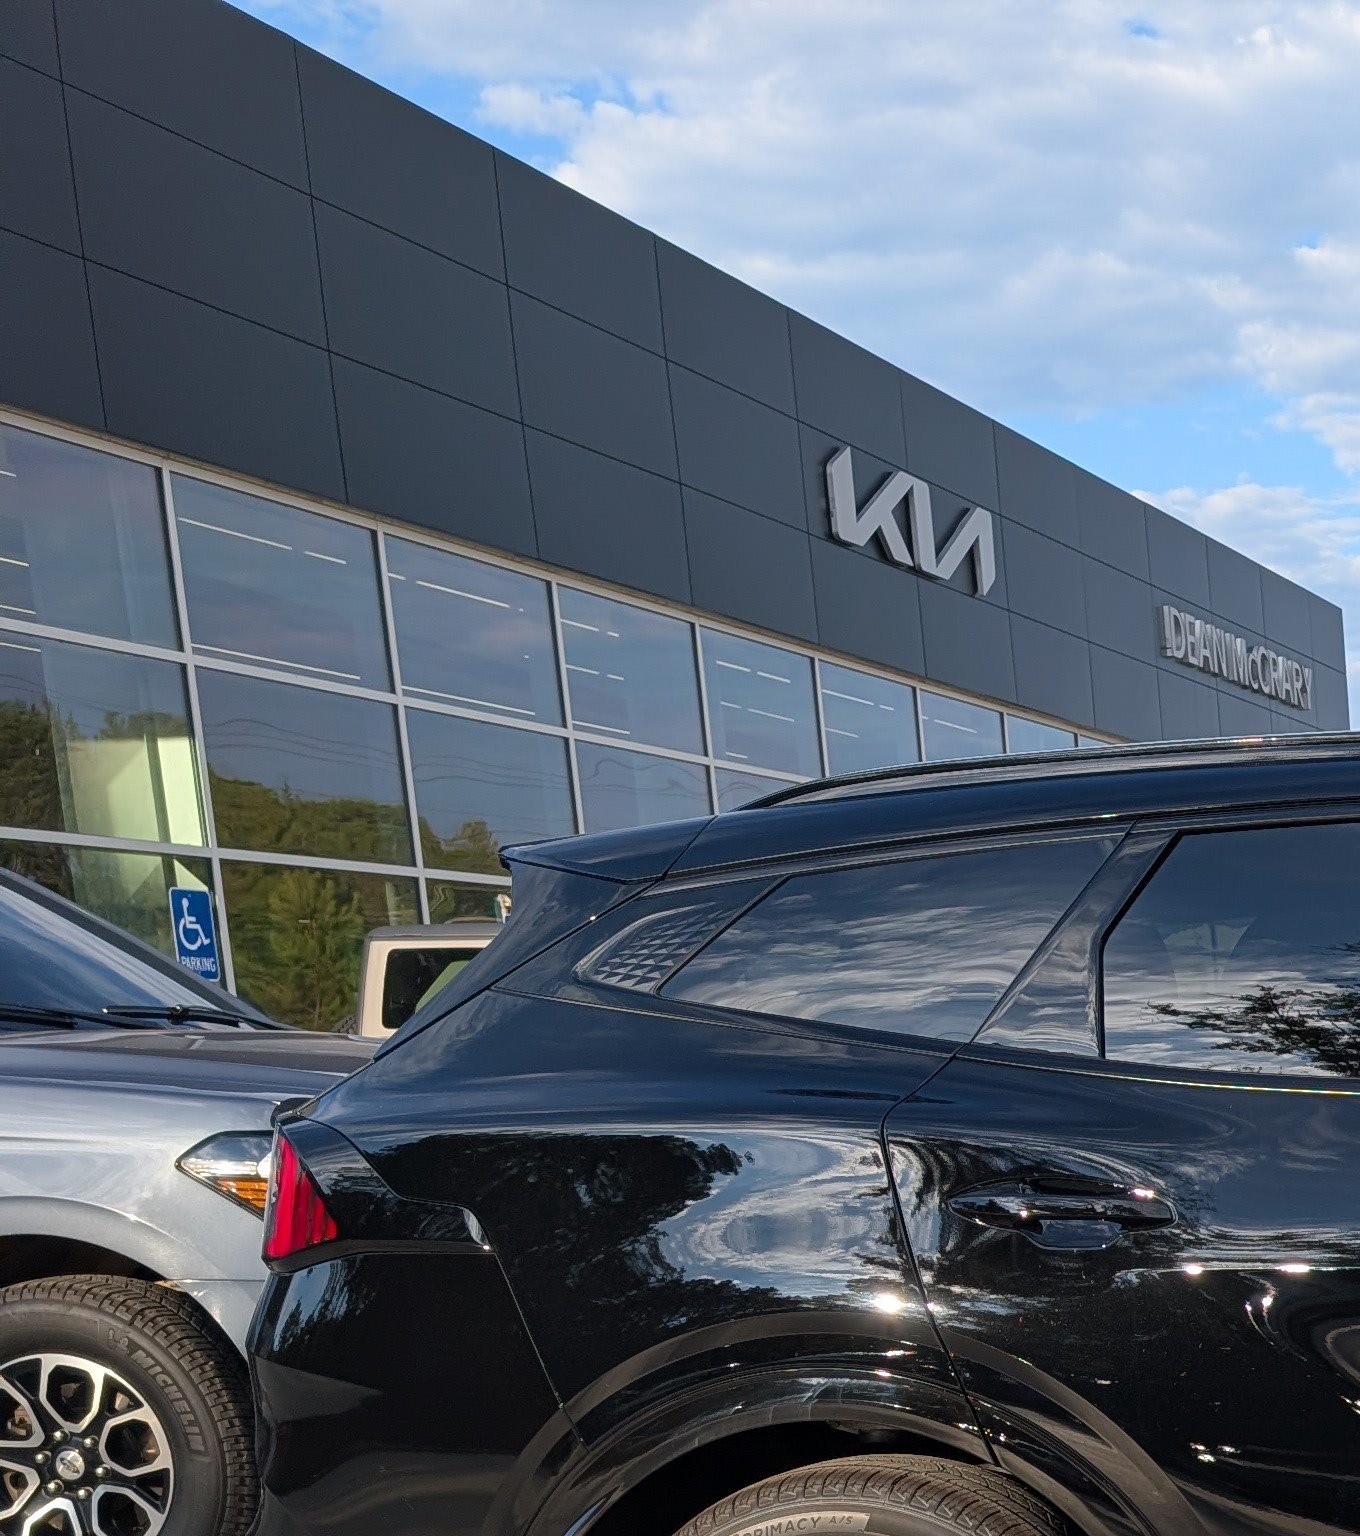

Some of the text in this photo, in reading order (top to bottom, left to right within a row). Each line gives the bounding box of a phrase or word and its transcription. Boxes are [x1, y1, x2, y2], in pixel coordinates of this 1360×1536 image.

[826, 446, 995, 597] KIA
[181, 956, 216, 973] PARKING
[829, 1514, 854, 1526] A/S
